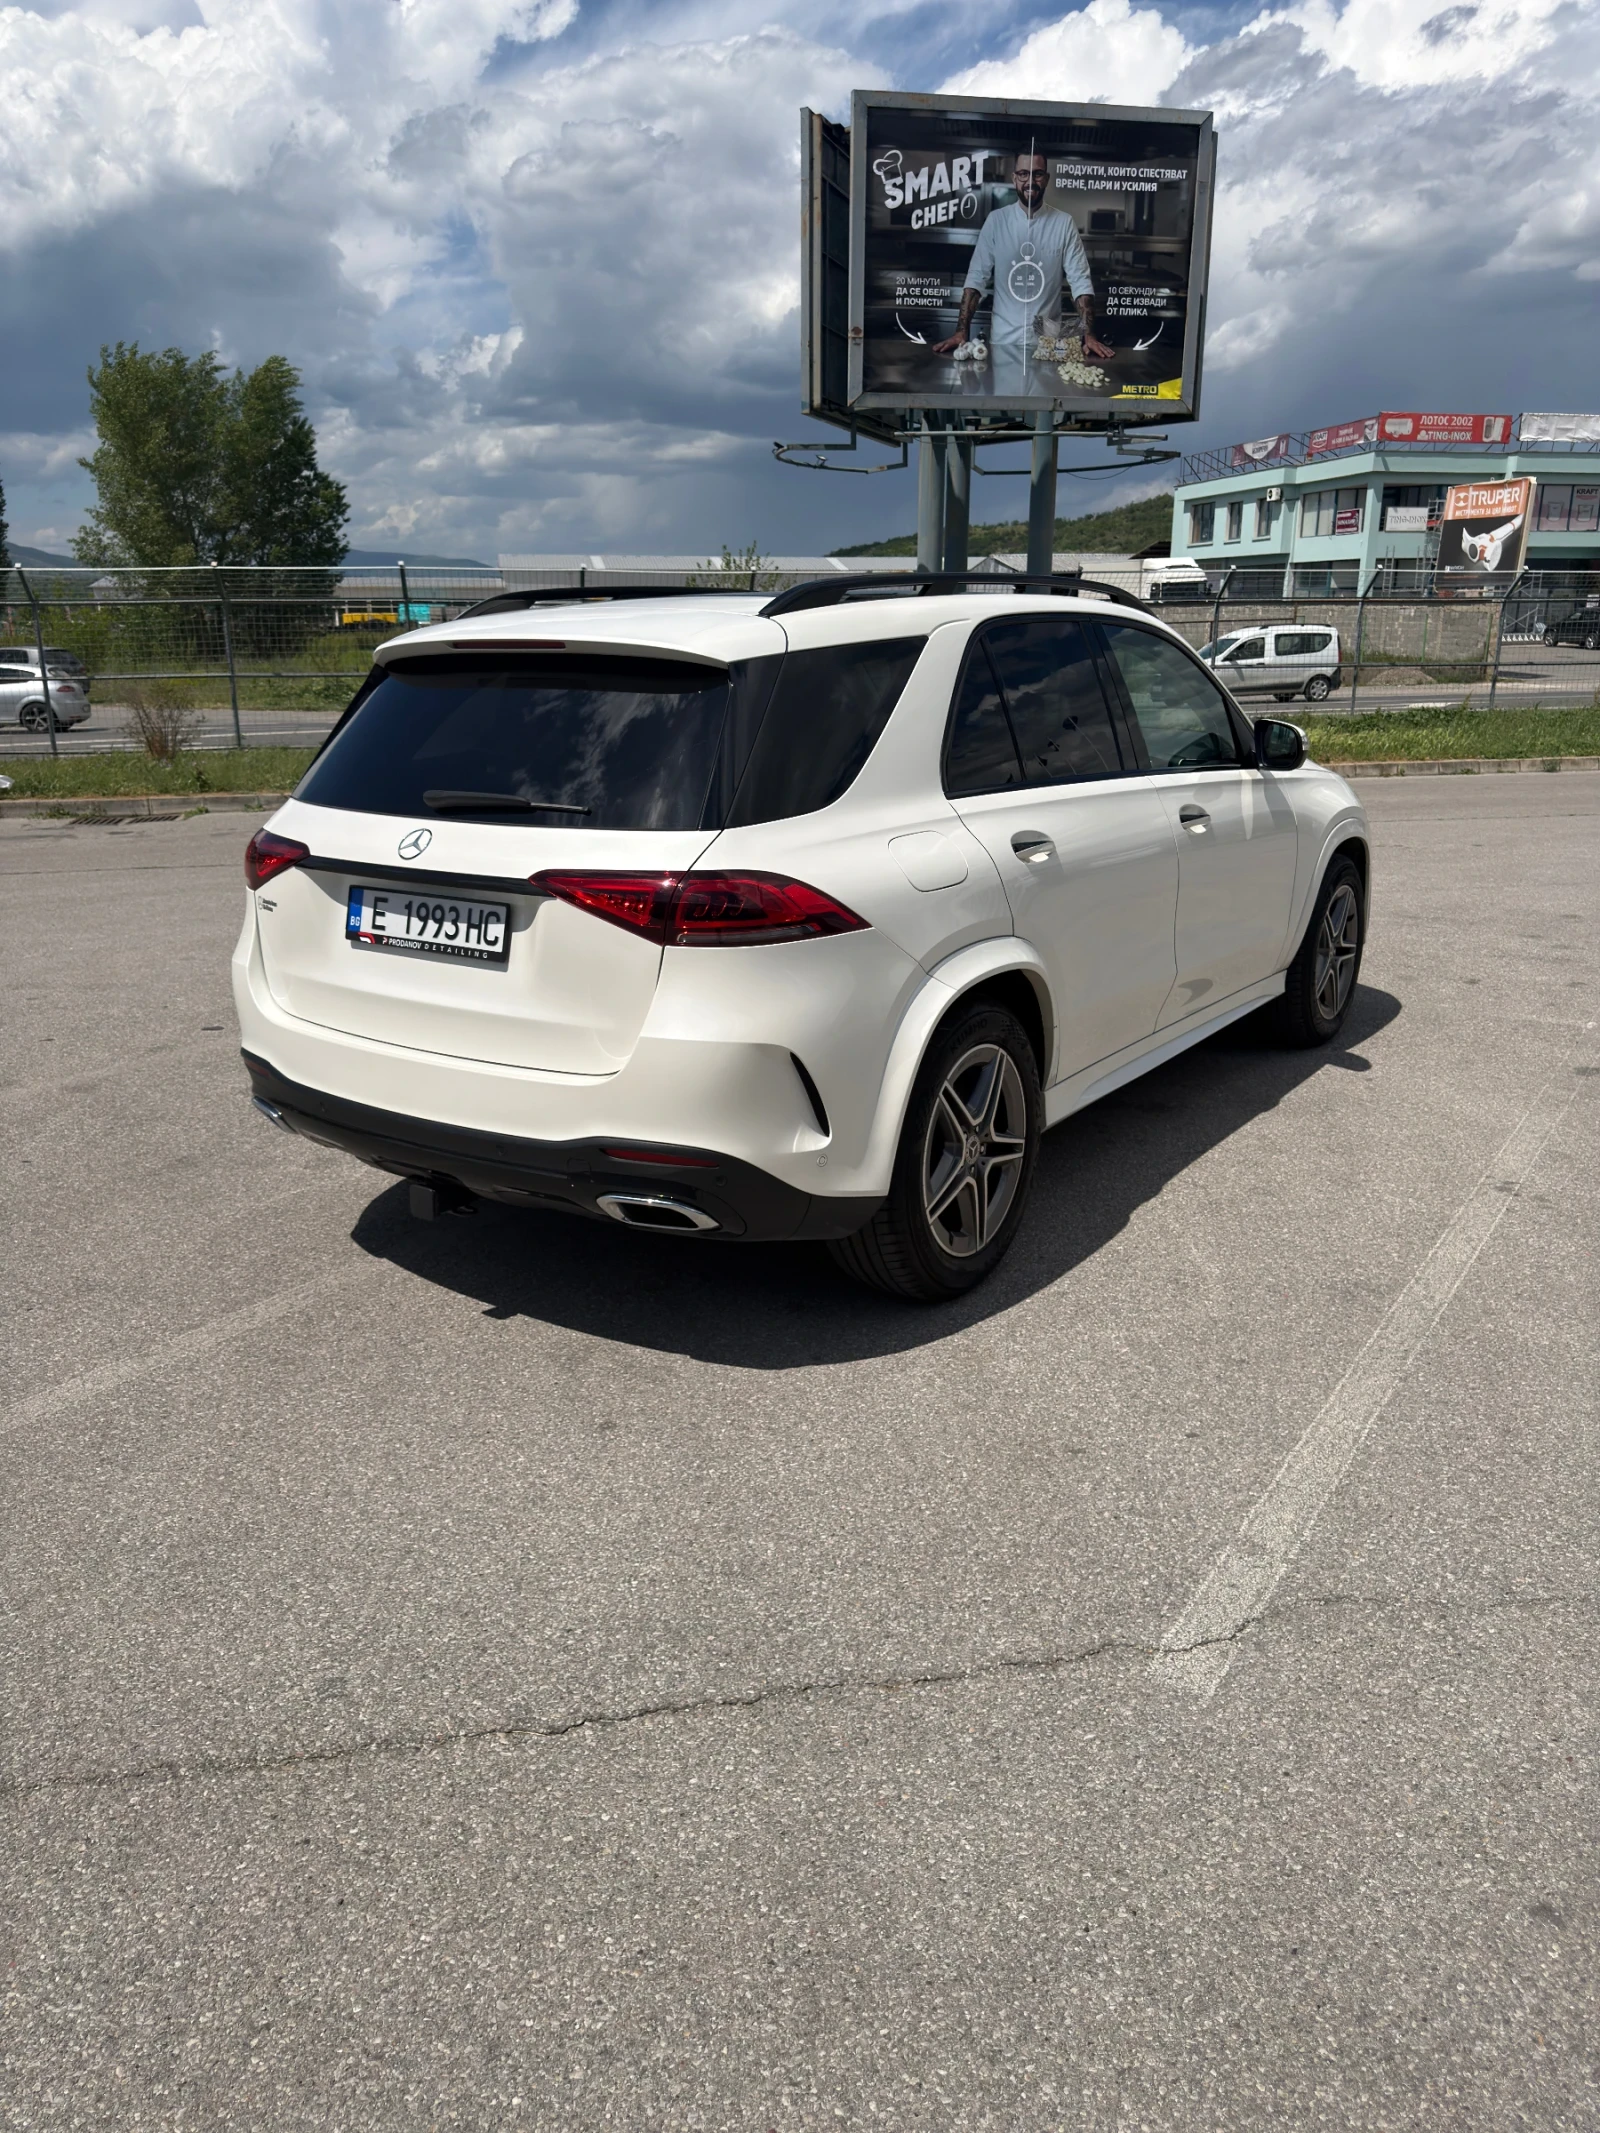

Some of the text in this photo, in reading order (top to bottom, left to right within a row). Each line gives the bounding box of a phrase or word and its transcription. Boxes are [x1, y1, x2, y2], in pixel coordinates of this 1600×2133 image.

[1056, 164, 1188, 180] ПРОДУКТИ, КОИТО СПЕСТЯВАТ
[884, 150, 989, 209] SMART
[1055, 178, 1158, 192] ВРЕМЕ, ПАРИ И УСИЛИЯ
[911, 198, 960, 230] CHEF
[896, 276, 941, 286] 20 МИНУТИ
[896, 287, 951, 297] ДА СЕ ОБЕЛИ
[1108, 286, 1156, 296] 10 СЕКУНДИ
[896, 297, 943, 307] И ПОЧИСТИ
[1106, 297, 1167, 308] ДА СЕ ИЗВАДИ
[1106, 307, 1148, 316] ОТ ПЛИКА
[1122, 385, 1157, 394] METRO
[1420, 415, 1474, 426] ЛОТОС 2002
[1471, 487, 1521, 506] TRUPER
[350, 916, 361, 927] BG
[372, 896, 501, 947] E 1993 HC
[388, 938, 488, 959] PRODANOV DETAILING
